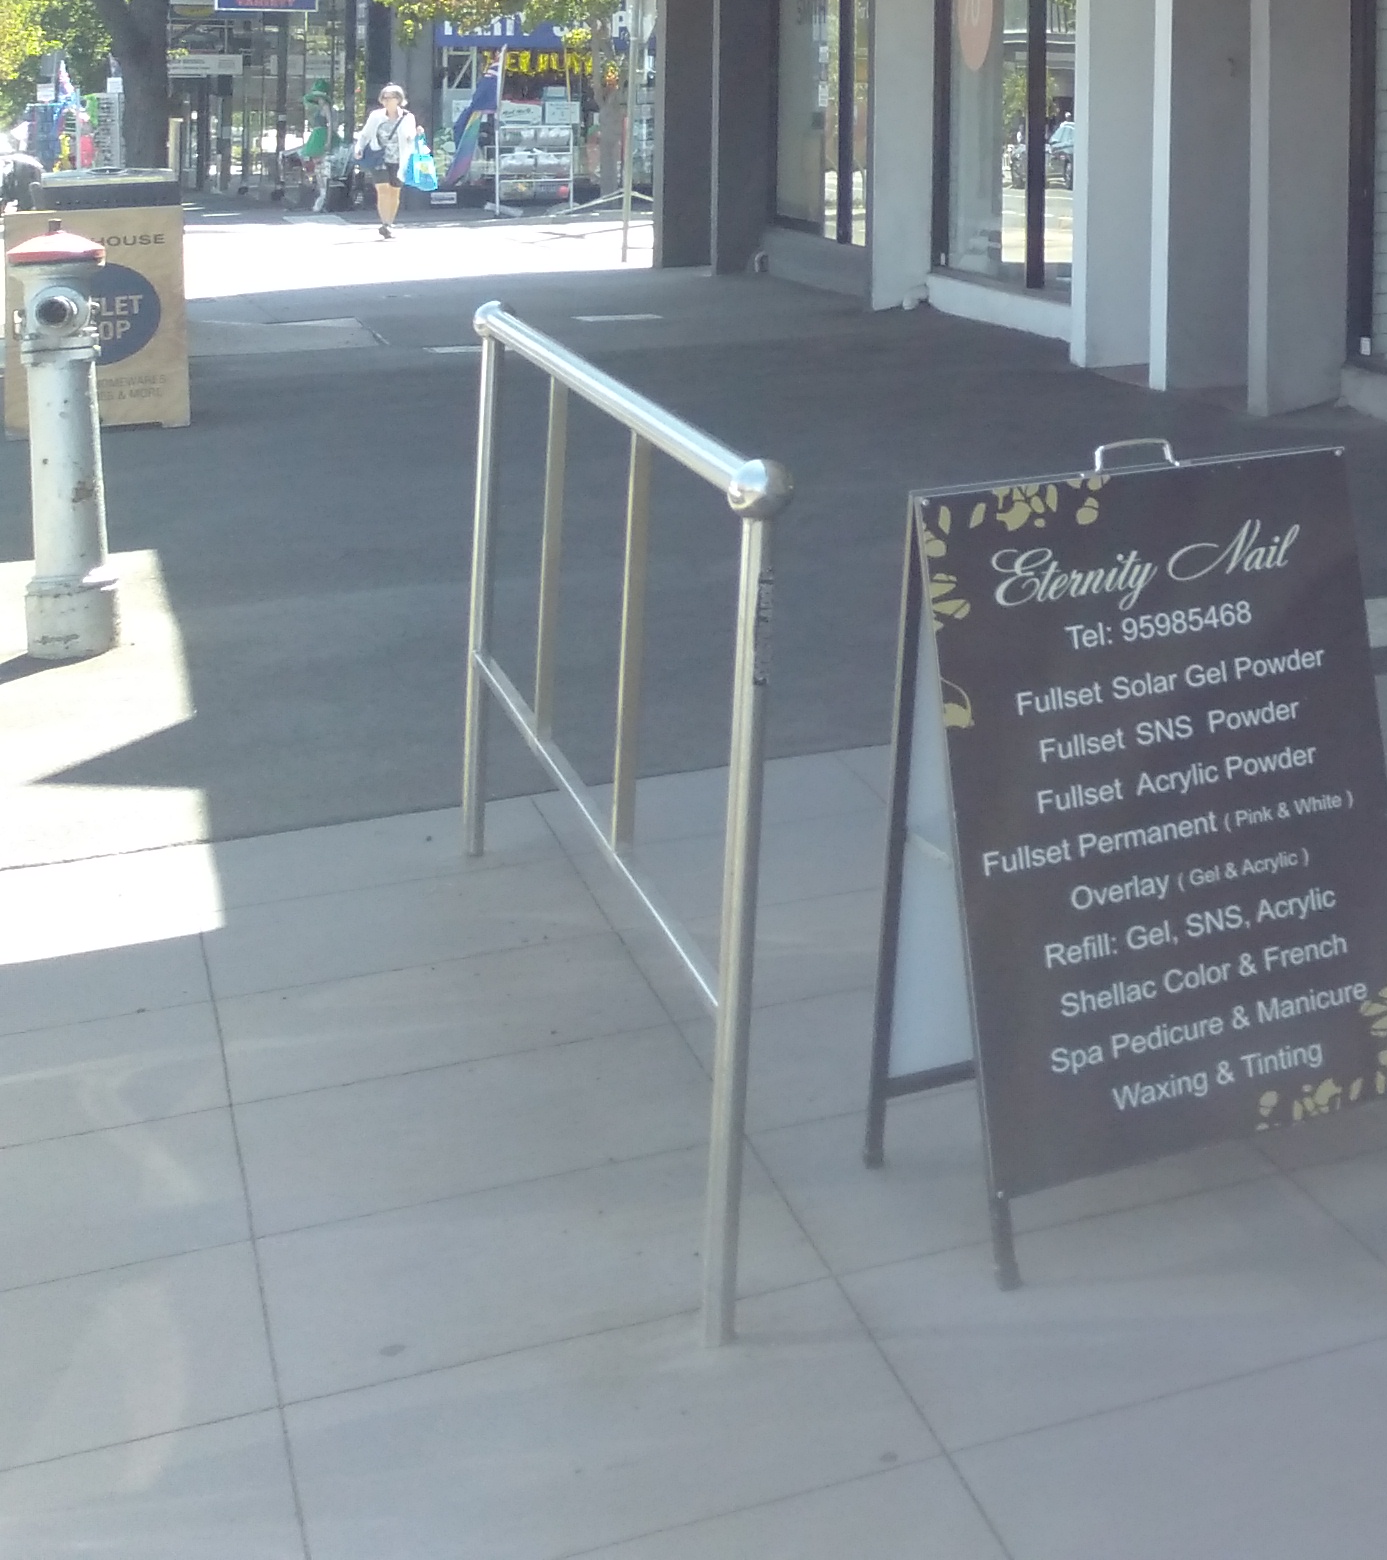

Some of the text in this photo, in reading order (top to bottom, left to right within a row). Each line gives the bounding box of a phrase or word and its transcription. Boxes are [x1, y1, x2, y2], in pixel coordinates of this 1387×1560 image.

[991, 519, 1300, 611] Eternity Nail
[1065, 600, 1252, 650] Tel: 95985468
[1016, 648, 1325, 716] Fullset Solar Gel Powder
[1038, 700, 1300, 763] Fullset SNS Powder
[1036, 744, 1318, 814] Fullset Acrylic Powder
[981, 841, 1072, 877] Fullset
[1078, 810, 1218, 859] Permanent
[1235, 804, 1274, 828] Pink
[1276, 800, 1290, 820] &
[1294, 791, 1343, 817] White
[1070, 871, 1170, 912] Overlay
[1189, 864, 1221, 888] Gel
[1225, 861, 1239, 880] &
[1242, 849, 1299, 878] Acrylic
[1044, 886, 1336, 969] Refill: Gel, SNS, Acrylic
[1060, 933, 1348, 1019] Shellac Color & French
[1050, 980, 1368, 1076] Spa Pedicure & Manicure
[1111, 1042, 1324, 1112] Waxing & Tinting
